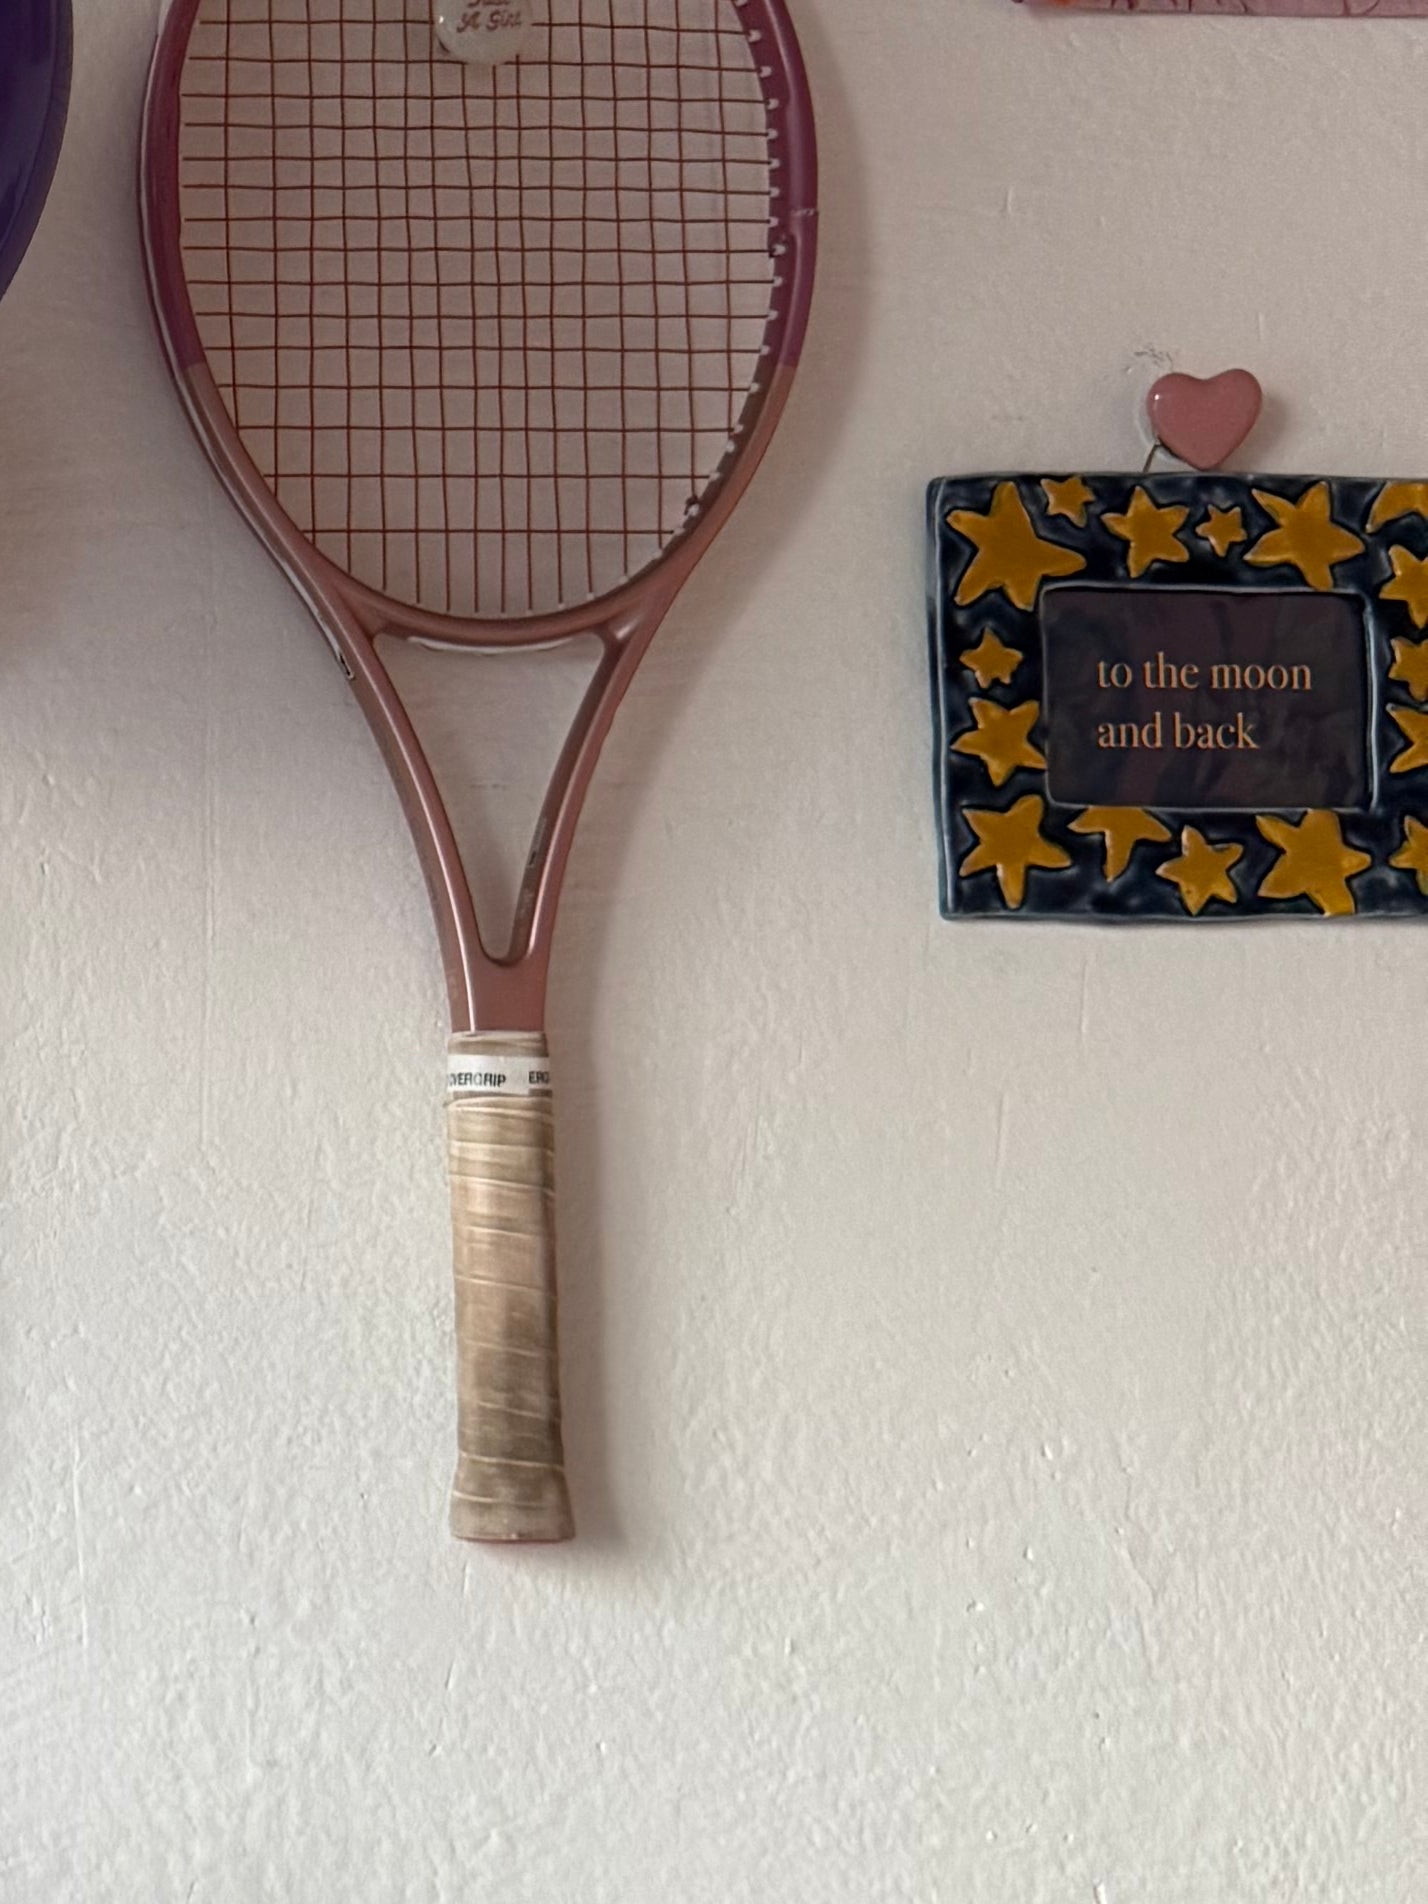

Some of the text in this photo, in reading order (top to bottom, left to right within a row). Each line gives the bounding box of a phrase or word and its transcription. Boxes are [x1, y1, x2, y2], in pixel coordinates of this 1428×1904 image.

[486, 10, 522, 31] Girl
[1097, 651, 1312, 691] to the moon
[1097, 711, 1260, 751] and back
